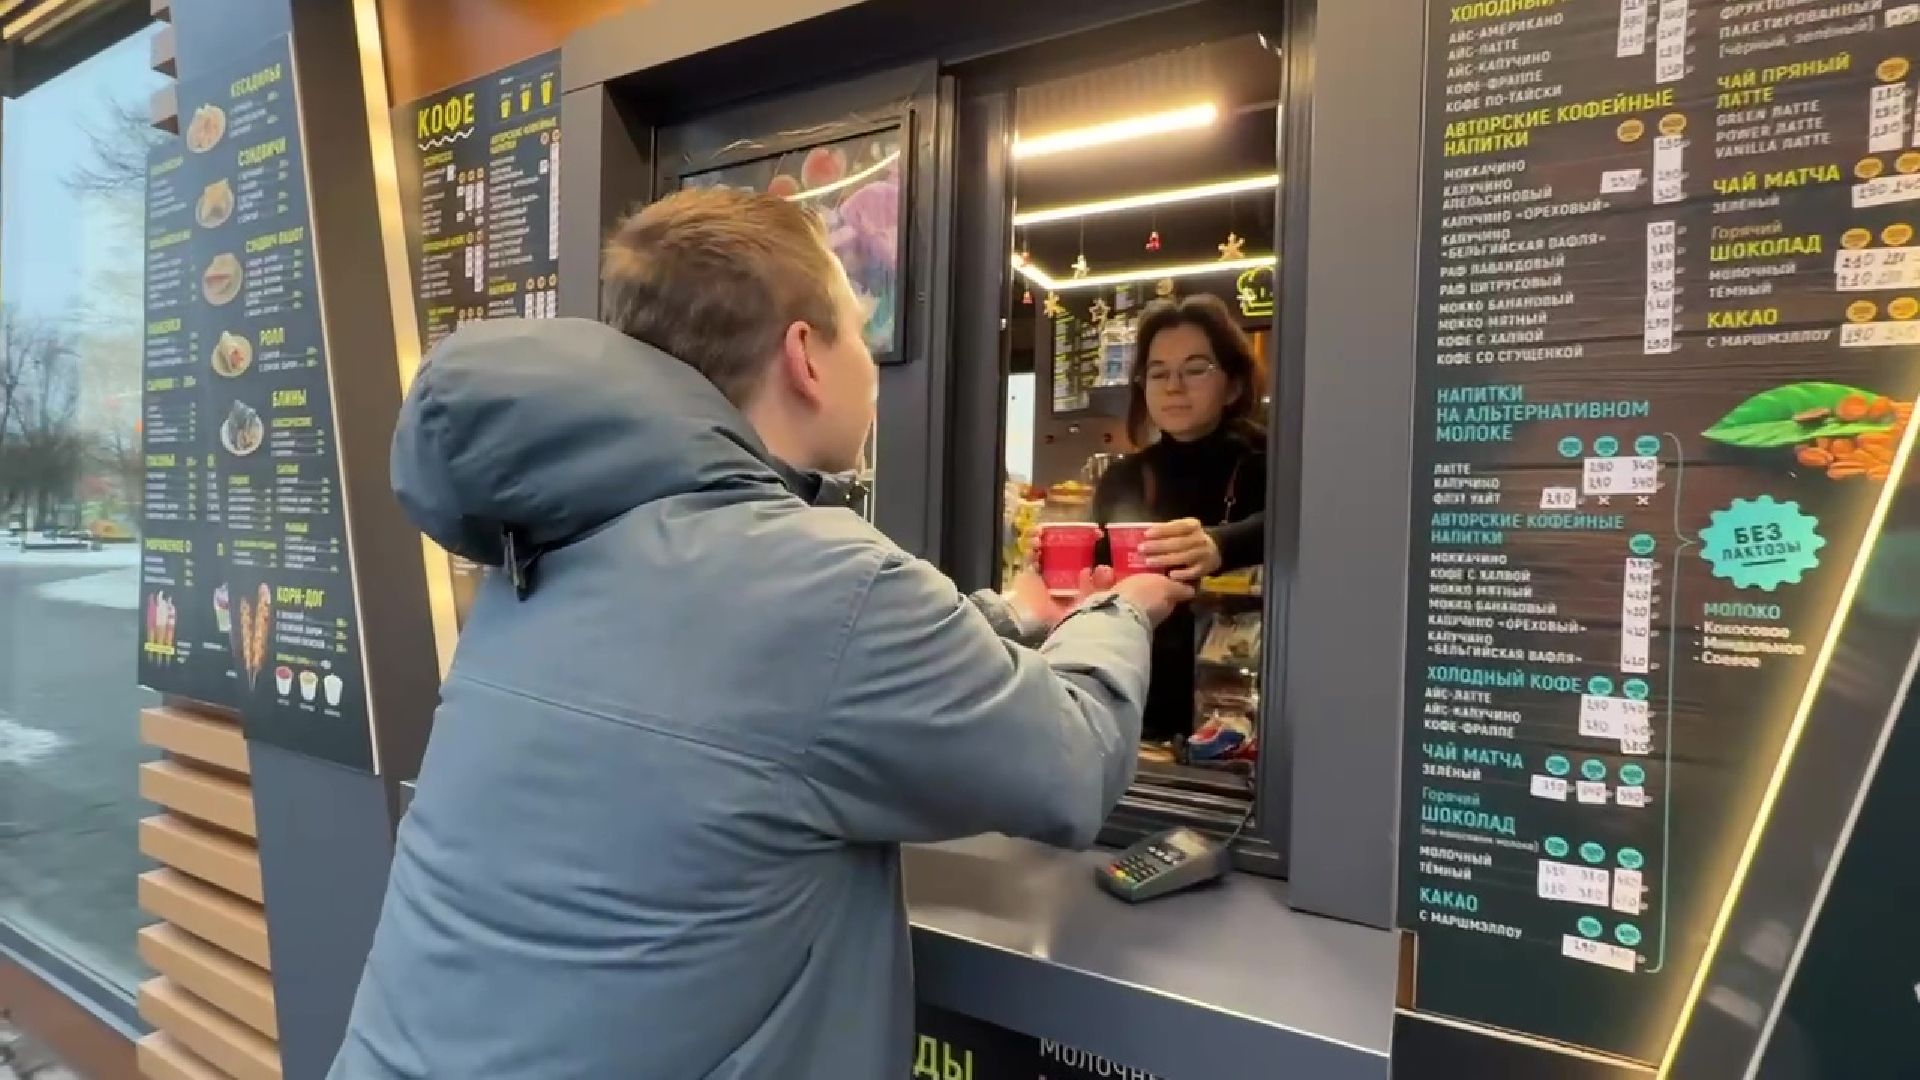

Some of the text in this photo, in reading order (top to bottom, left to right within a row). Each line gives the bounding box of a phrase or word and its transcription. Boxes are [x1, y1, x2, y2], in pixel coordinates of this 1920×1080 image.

[1717, 52, 1850, 89] ЧАЙ ПРЯНЫЙ
[1445, 85, 1562, 114] КОФЕ ПО-ТАЙСКИ
[1716, 87, 1774, 109] ЛАТТЕ
[418, 93, 475, 139] КОФЕ
[1445, 88, 1673, 138] АВТОРСКИЕ КОФЕЙНЫЕ
[1773, 100, 1820, 119] ЛАТТЕ
[1716, 117, 1823, 142] POWER ЛАТТЕ
[1444, 131, 1528, 156] НАПИТКИ
[1716, 133, 1832, 160] VANILLA ЛАТТЕ
[1713, 172, 1757, 194] ЧАЙ
[1765, 164, 1840, 189] МАТЧА
[1710, 235, 1821, 262] ШОКОЛАД
[1440, 264, 1466, 277] РАФ
[1440, 283, 1465, 295] РАФ
[1439, 300, 1483, 313] МОККО
[1438, 318, 1481, 331] МОККО
[1708, 308, 1778, 328] КАКАО
[1437, 334, 1471, 347] КОФЕ
[1707, 337, 1715, 349] С
[1437, 351, 1471, 365] КОФЕ
[1476, 350, 1492, 364] СО
[1437, 385, 1524, 403] НАПИТКИ
[1437, 400, 1649, 423] НА АЛЬТЕРНАТИВНОМ
[1436, 424, 1512, 442] МОЛОКЕ
[1434, 463, 1471, 475] ЛАТТЕ
[1434, 478, 1500, 489] КАПУЧИНО
[1431, 513, 1624, 529] АВТОРСКИЕ КОФЕЙНЫЕ
[1431, 531, 1503, 545] НАПИТКИ
[1734, 522, 1783, 544] БЕЗ
[1722, 541, 1801, 561] ЛАКТОЗЫ
[1430, 569, 1462, 580] КОФЕ
[1704, 603, 1780, 620] МОЛОКО
[1428, 666, 1582, 693] ХОЛОДНЫЙ КОФЕ
[1423, 742, 1524, 769] ЧАЙ МАТЧА
[1422, 786, 1480, 805] Горячий
[1422, 804, 1516, 835] ШОКОЛАД
[1420, 846, 1492, 867] МОЛОЧНЫЙ
[1420, 888, 1478, 911] КАКАО
[1419, 910, 1522, 939] С МАРШМЭЛЛОУ
